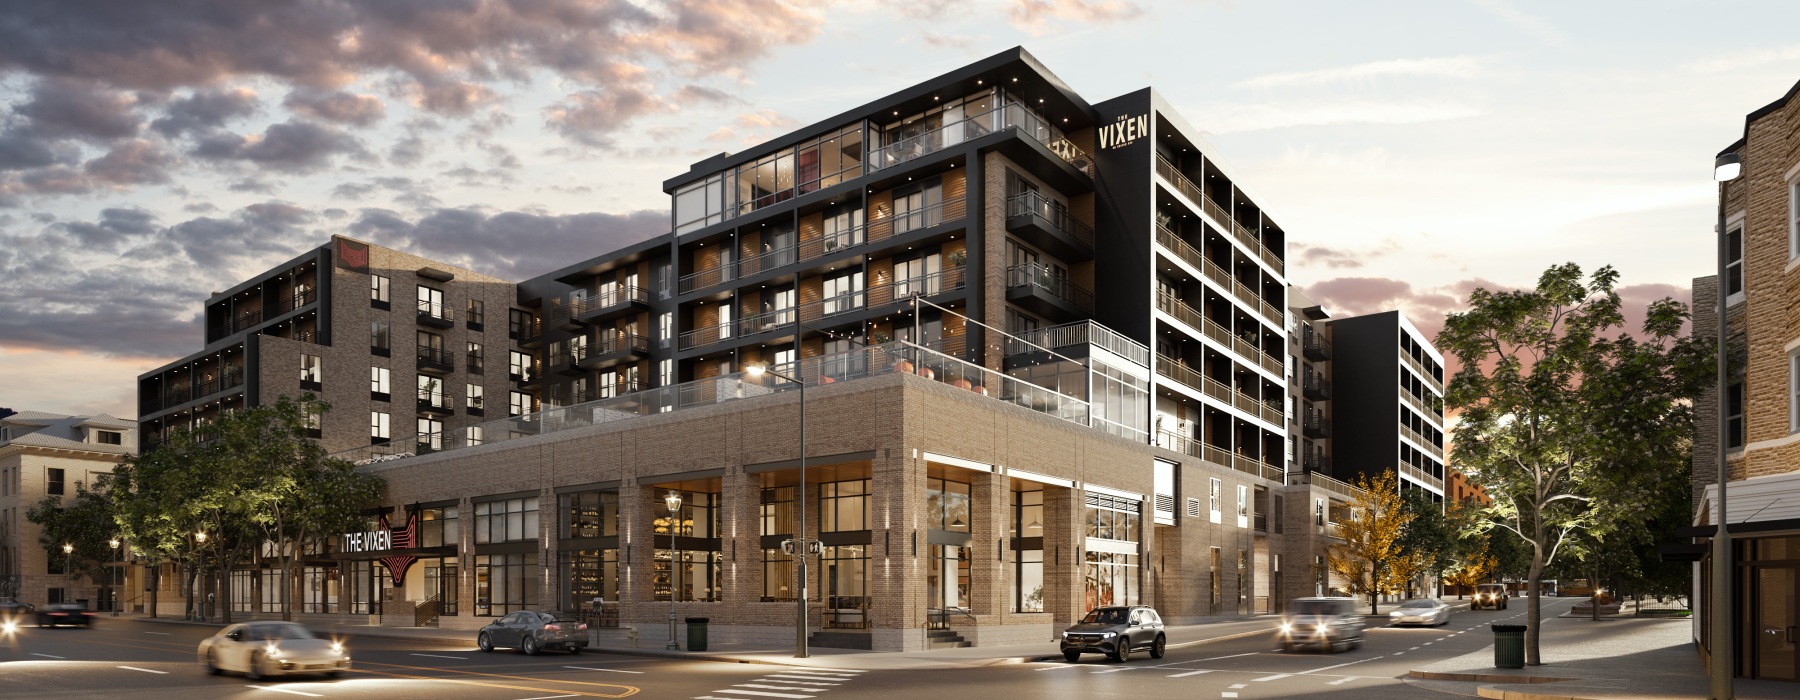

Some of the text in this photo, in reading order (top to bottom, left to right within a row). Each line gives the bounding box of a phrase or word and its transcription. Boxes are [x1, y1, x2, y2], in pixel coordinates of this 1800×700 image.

[1098, 113, 1148, 149] VIXEN
[345, 530, 391, 552] THE VIXEN
